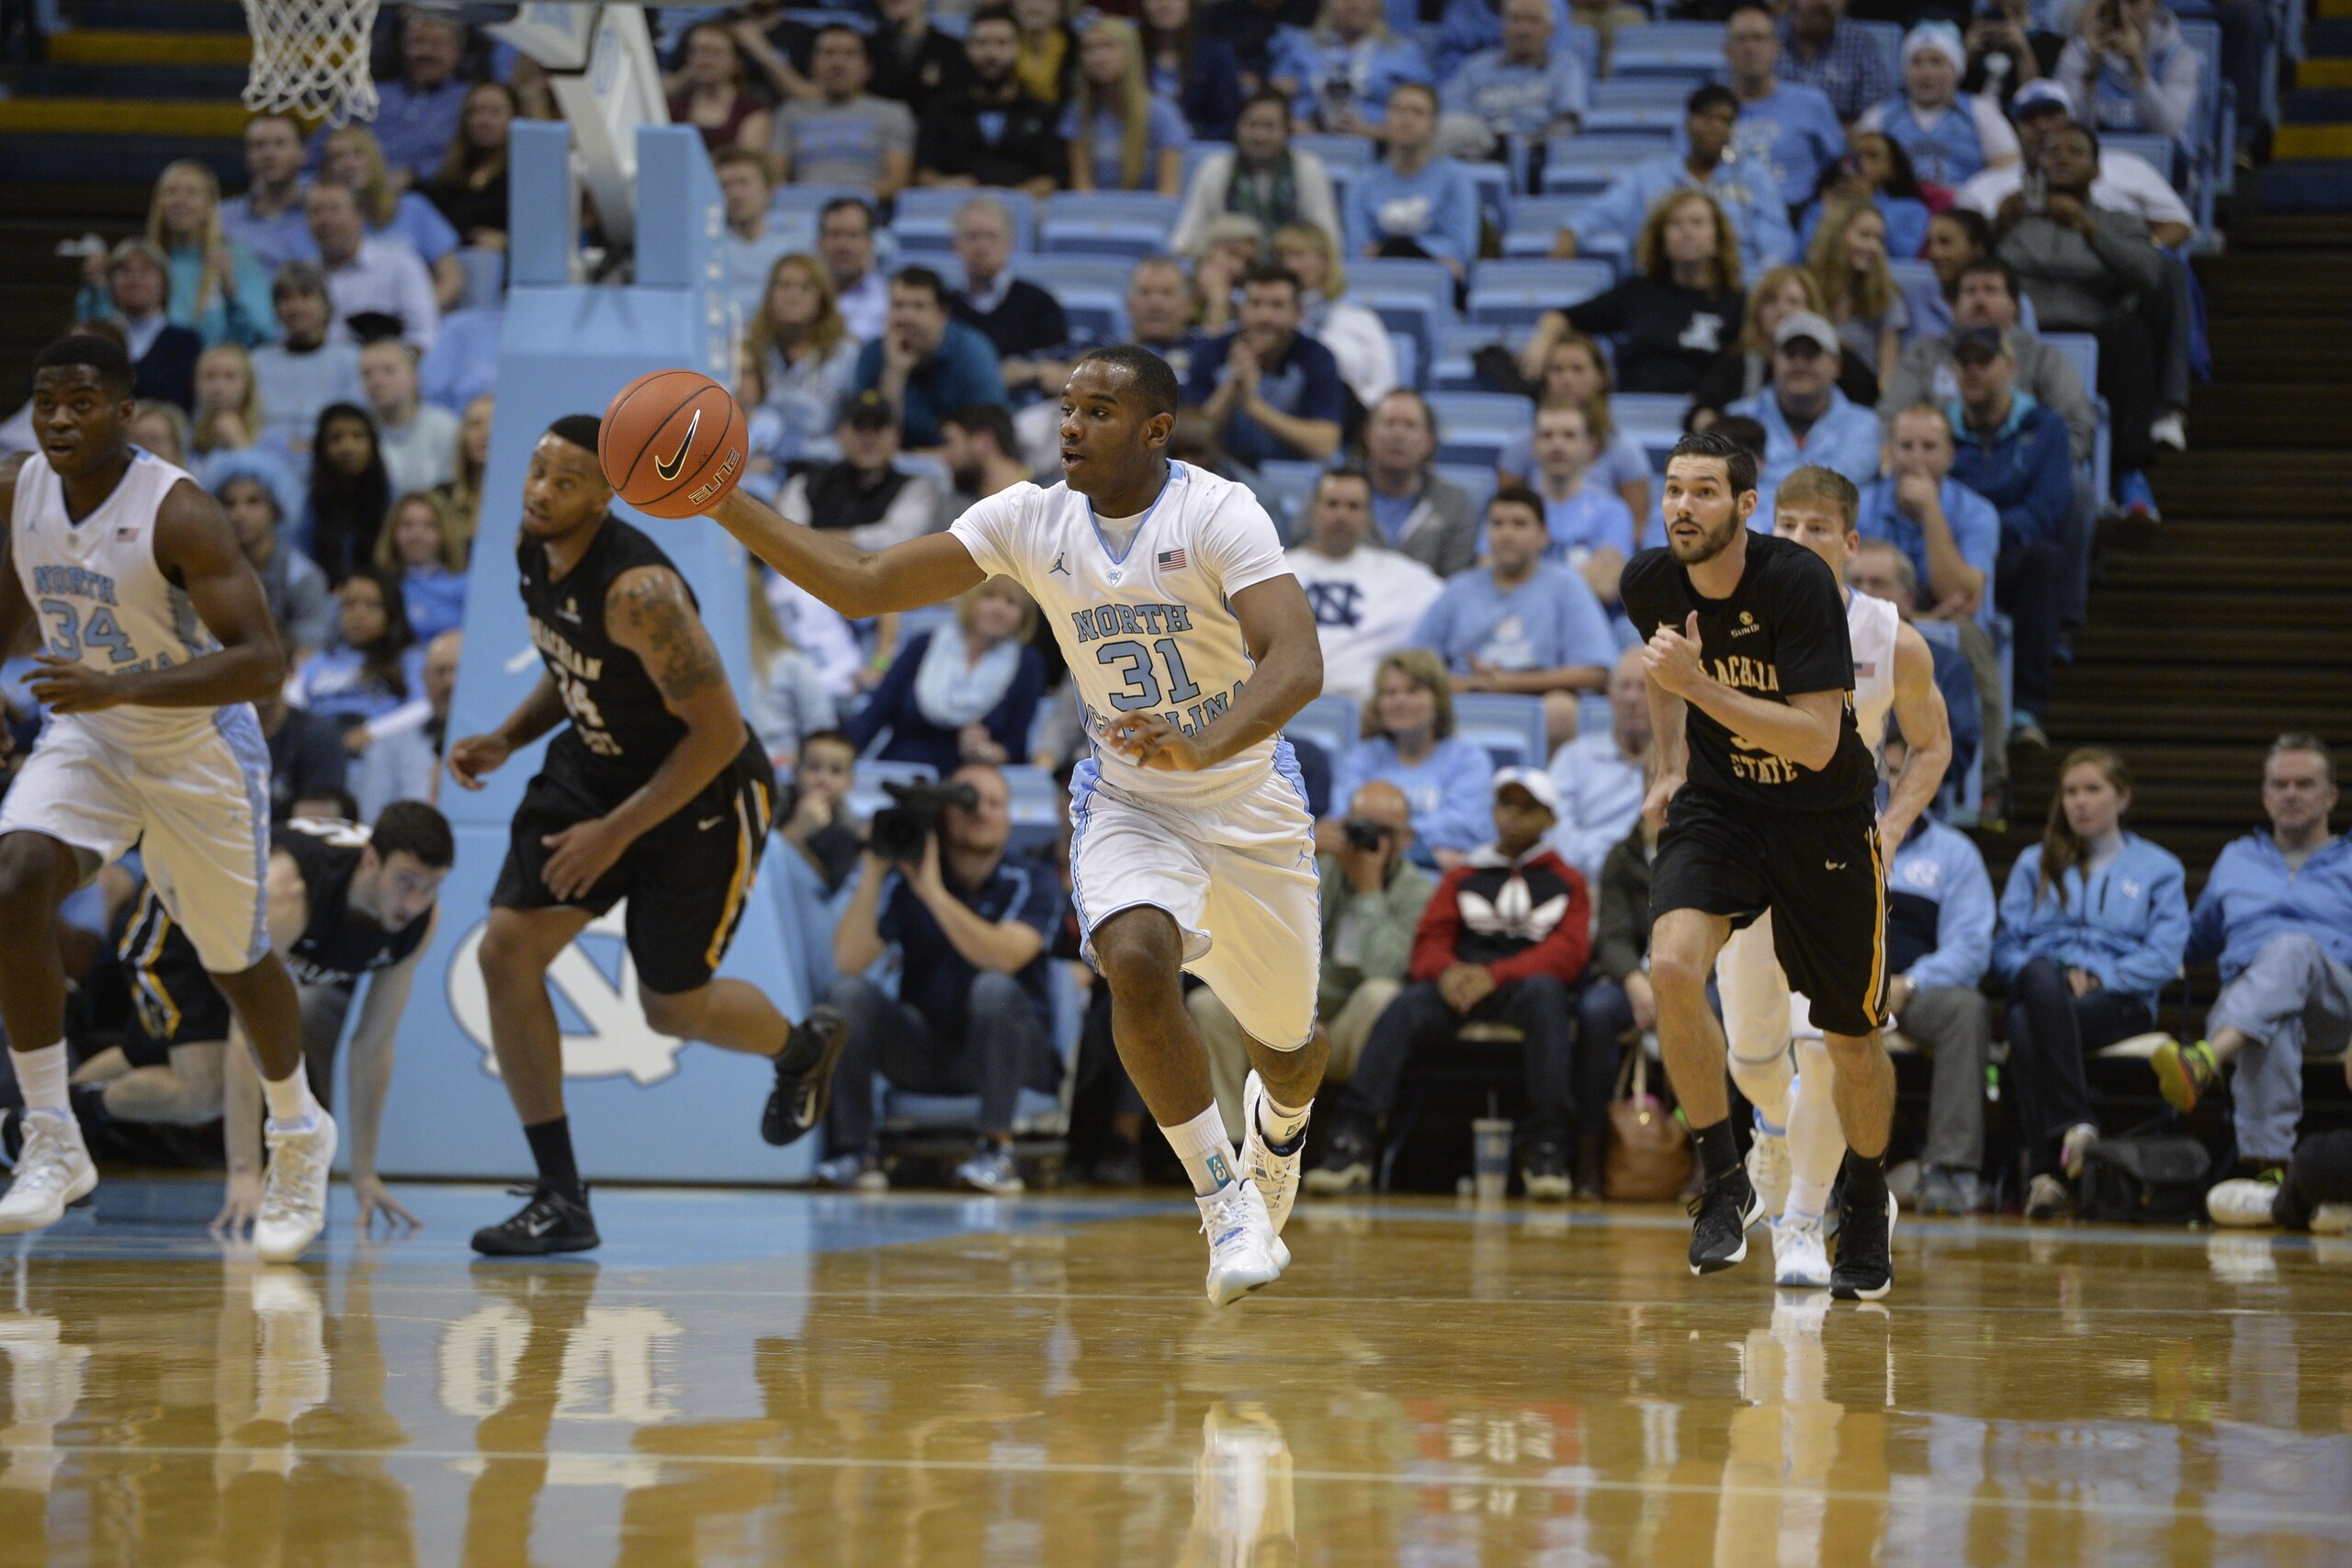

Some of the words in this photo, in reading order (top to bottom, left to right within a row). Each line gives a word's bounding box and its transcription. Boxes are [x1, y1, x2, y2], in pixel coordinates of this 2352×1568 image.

[687, 447, 741, 505] ELITE
[33, 565, 119, 606] NORTH
[40, 598, 137, 663] 34
[1071, 604, 1193, 643] NORTH
[1096, 637, 1201, 712] 31
[1729, 753, 1799, 784] STATE
